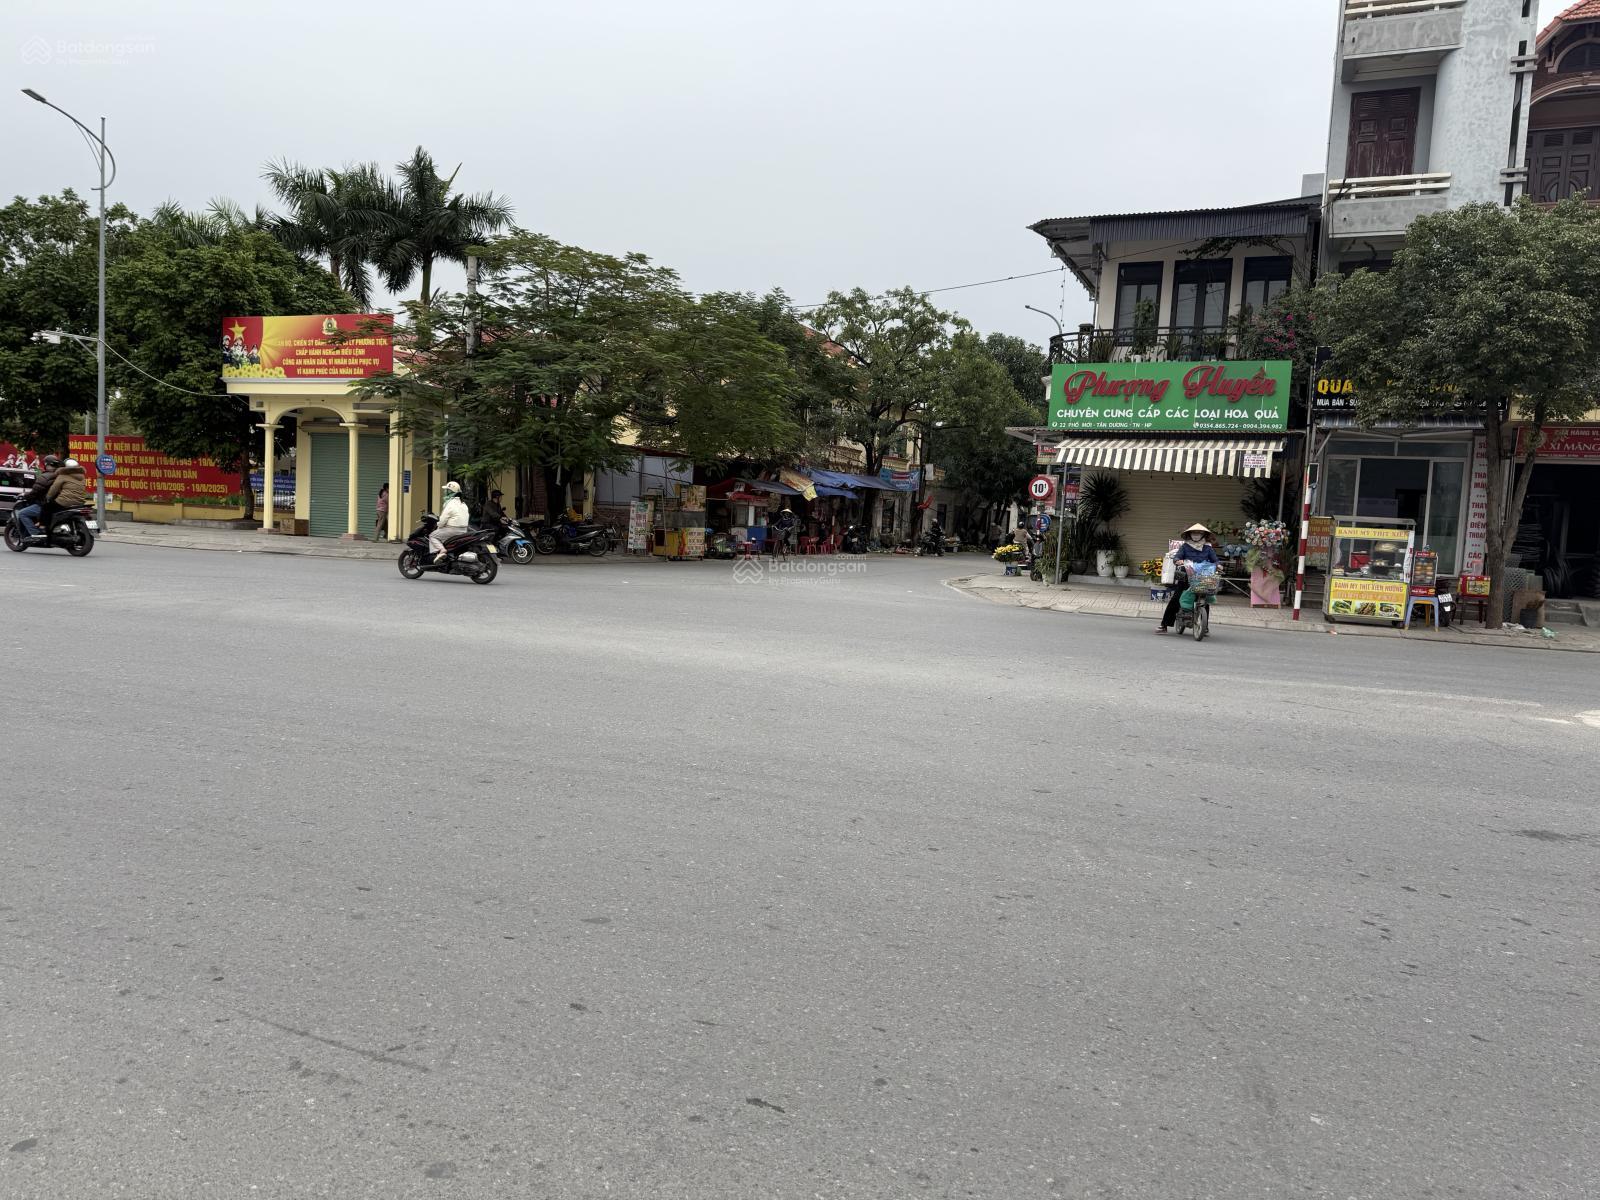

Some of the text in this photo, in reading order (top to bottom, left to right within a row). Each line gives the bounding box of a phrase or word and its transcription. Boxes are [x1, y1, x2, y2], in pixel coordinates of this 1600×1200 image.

[282, 357, 296, 366] CÔNG
[1064, 370, 1170, 404] Phượng
[1318, 379, 1353, 394] QUA
[1316, 398, 1330, 406] MUA
[1332, 397, 1344, 406] BÁN
[1056, 404, 1280, 420] CHUYÊN CUNG CẤP CÁC LOẠI HOA QUẢ
[69, 440, 82, 450] HÀO
[84, 440, 98, 450] MỪN
[114, 442, 130, 452] NIỆM
[80, 454, 89, 462] AN
[124, 453, 138, 466] VIỆT
[140, 456, 154, 464] NAM
[132, 466, 149, 477] NGÀY
[150, 467, 162, 479] HỘI
[164, 468, 182, 479] TOÀN
